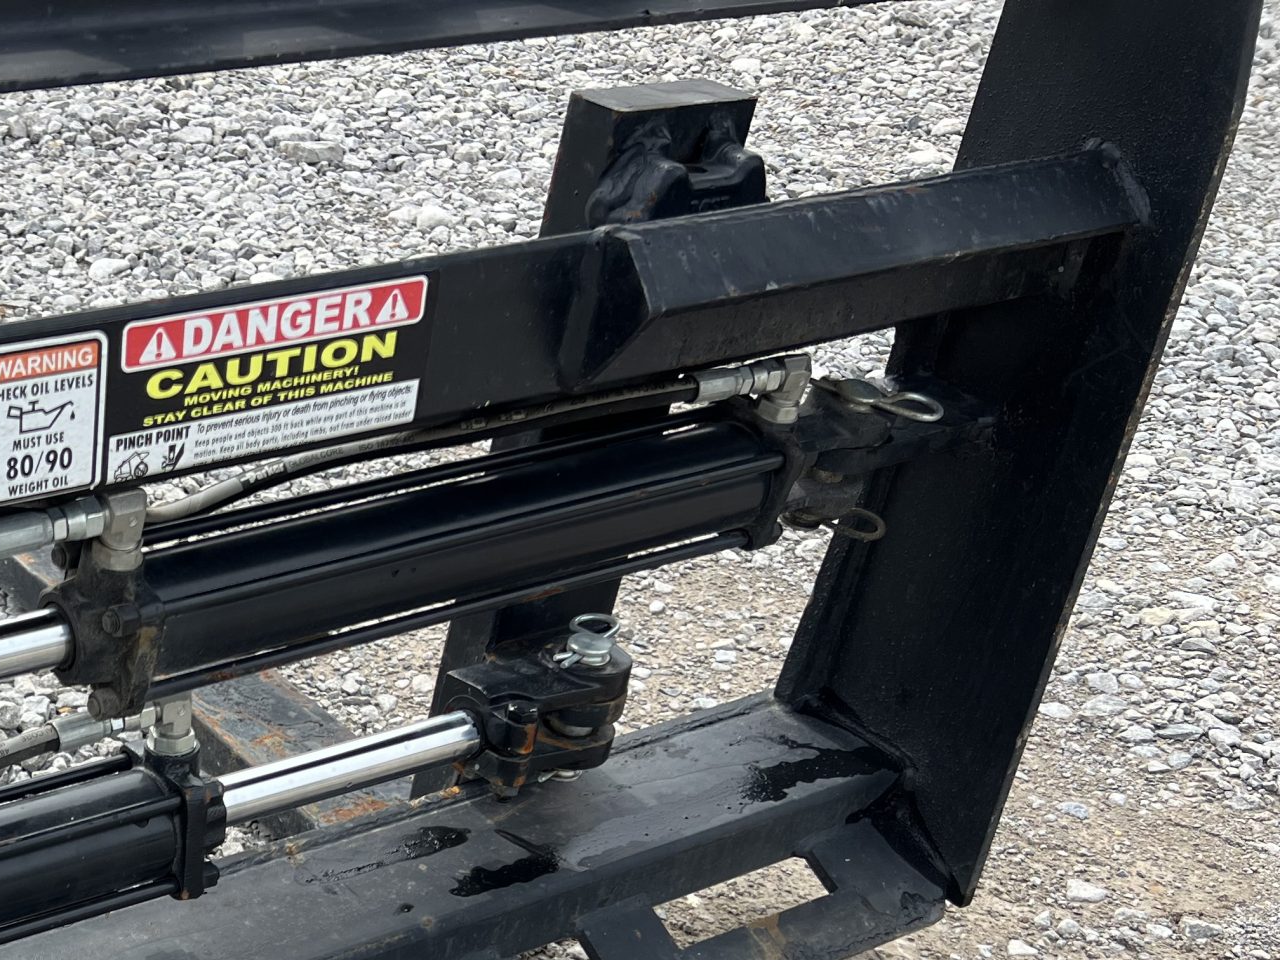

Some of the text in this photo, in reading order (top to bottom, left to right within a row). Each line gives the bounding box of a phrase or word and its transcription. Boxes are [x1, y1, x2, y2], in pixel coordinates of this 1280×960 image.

[182, 291, 372, 357] DANGER
[31, 382, 49, 396] OIL
[54, 374, 93, 393] LEVELS
[146, 330, 397, 400] CAUTION
[183, 365, 360, 406] MOVING MACHINERY!
[143, 371, 394, 427] STAY CLEAR OF THIS MACHINE
[197, 423, 205, 434] To
[206, 419, 233, 435] prevent
[234, 414, 260, 427] serious
[261, 409, 282, 423] injury
[283, 409, 291, 417] or
[291, 404, 311, 416] death
[312, 401, 329, 412] from
[329, 395, 359, 411] pinching
[360, 394, 368, 402] or
[368, 389, 386, 403] flying
[12, 432, 64, 451] MUST USE
[116, 426, 191, 452] PINCH POINT
[194, 438, 209, 448] Keep
[211, 433, 233, 445] people
[234, 430, 245, 440] and
[247, 426, 269, 438] objects
[306, 415, 322, 426] while
[323, 414, 334, 422] any
[335, 411, 348, 421] part
[349, 409, 355, 418] of
[357, 406, 368, 416] this
[369, 402, 393, 413] machine
[220, 445, 235, 454] Keep
[236, 441, 244, 450] all
[246, 438, 260, 449] body
[281, 430, 309, 443] including
[341, 420, 354, 430] from
[356, 416, 373, 428] under
[374, 413, 391, 424] raised
[393, 408, 412, 420] loader
[6, 447, 73, 480] 80/90
[8, 476, 68, 496] WEIGHT OIL
